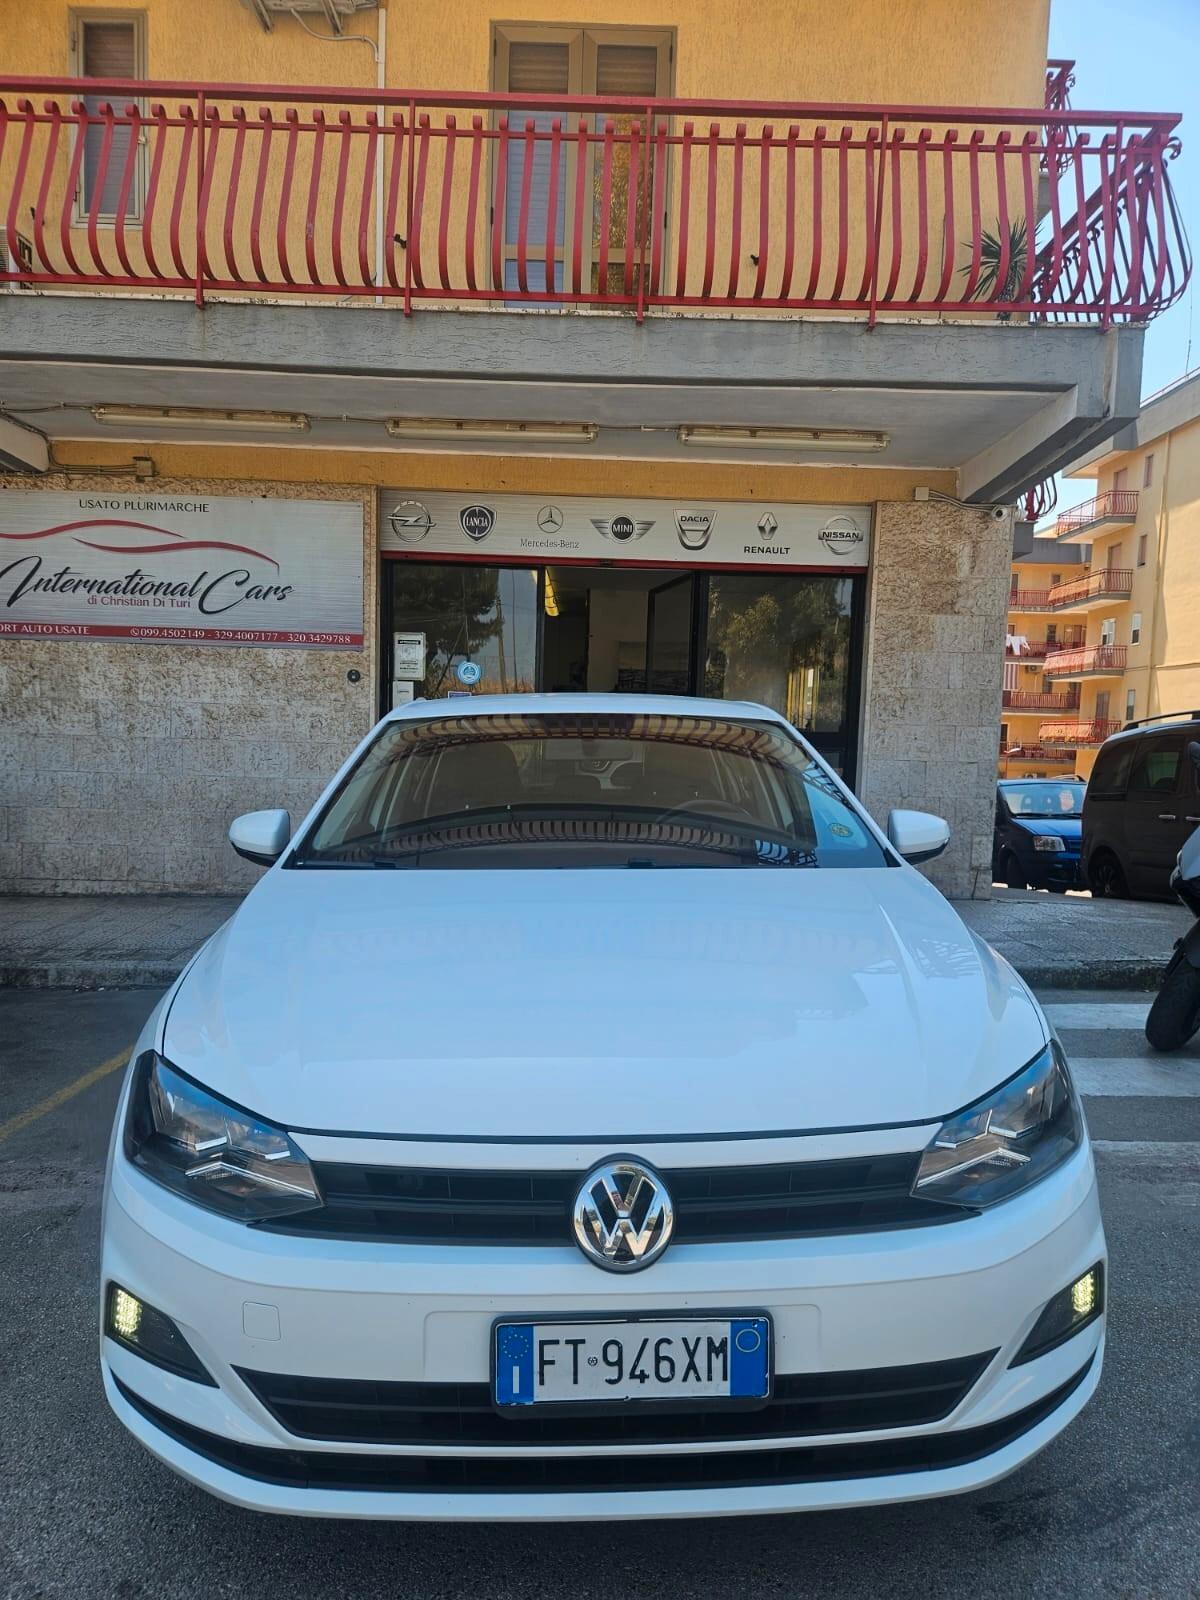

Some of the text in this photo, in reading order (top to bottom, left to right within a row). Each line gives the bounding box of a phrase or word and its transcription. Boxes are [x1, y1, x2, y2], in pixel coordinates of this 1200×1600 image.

[79, 499, 210, 513] USATO PLURIMARCHE
[466, 516, 489, 527] LANCIA
[680, 515, 710, 523] DACIA
[612, 524, 633, 533] MINI
[822, 531, 860, 540] NISSAN
[520, 538, 580, 549] Mercedes-Benz
[744, 546, 790, 555] RENAULT
[0, 555, 294, 615] International Cars
[87, 595, 191, 609] di Christian Di Turi
[21, 624, 53, 633] AUTO
[55, 626, 90, 635] USATE
[140, 628, 205, 638] 099.4502149
[214, 630, 278, 641] 329.4007177
[287, 633, 351, 644] 320.3429788
